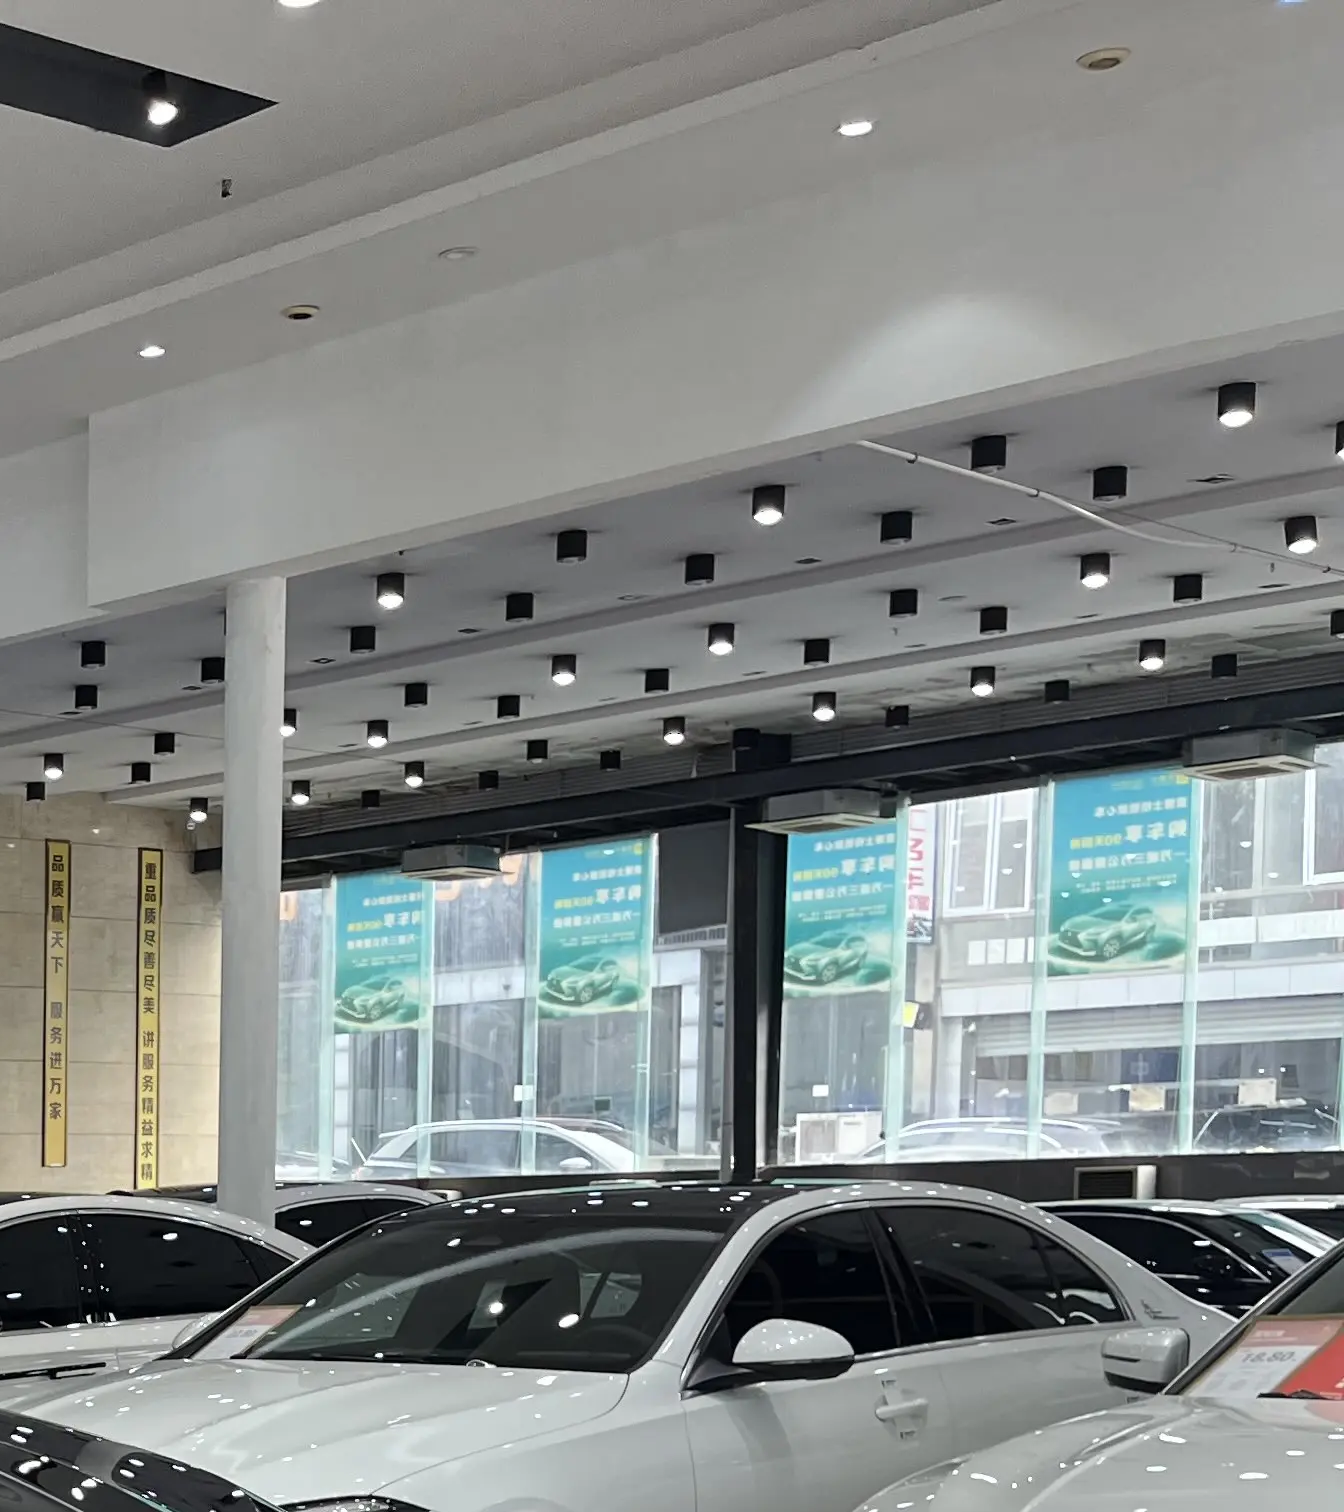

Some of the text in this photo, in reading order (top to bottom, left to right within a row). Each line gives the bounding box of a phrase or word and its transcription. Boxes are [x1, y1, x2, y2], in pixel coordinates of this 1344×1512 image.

[48, 854, 65, 1120] 品质赢天下 服务进万家
[142, 861, 157, 1015] 重品质尽善尽美
